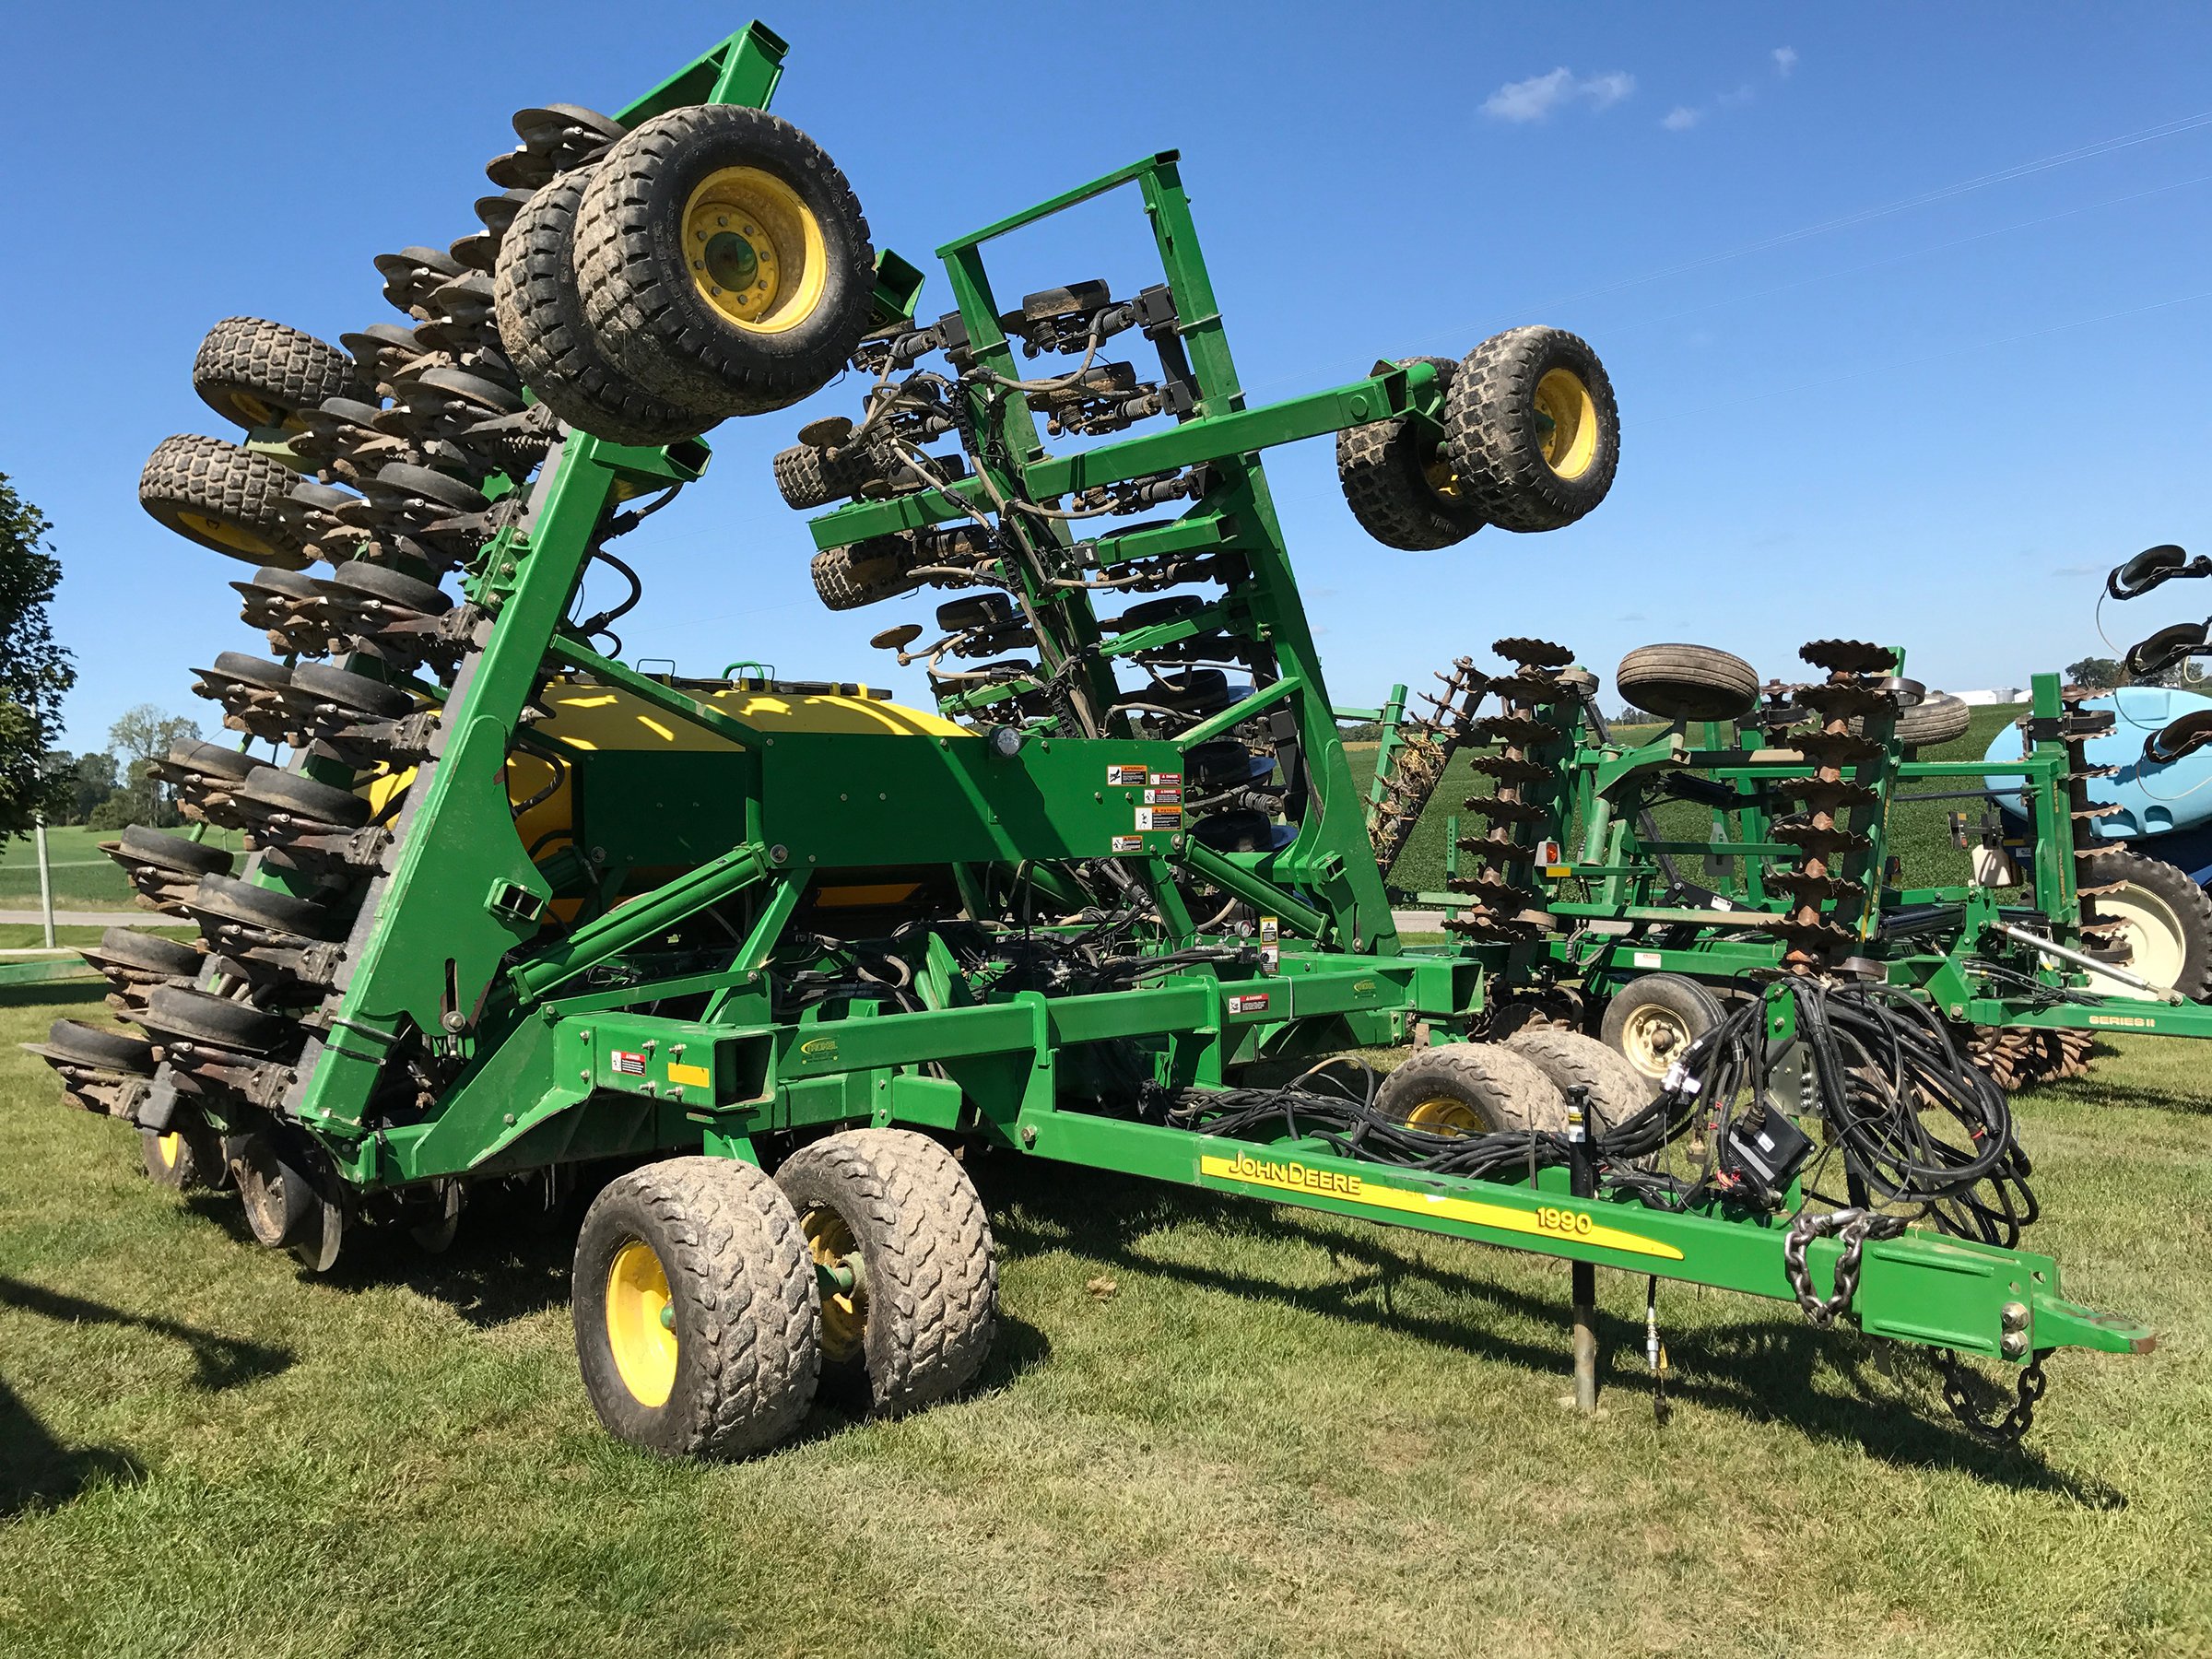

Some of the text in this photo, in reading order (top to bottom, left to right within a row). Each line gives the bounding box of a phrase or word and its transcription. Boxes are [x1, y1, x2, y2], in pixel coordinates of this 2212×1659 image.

[2088, 1016, 2156, 1028] SERIES II
[1230, 1153, 1361, 1195] JOHN DEERE
[1536, 1206, 1593, 1235] 1990
